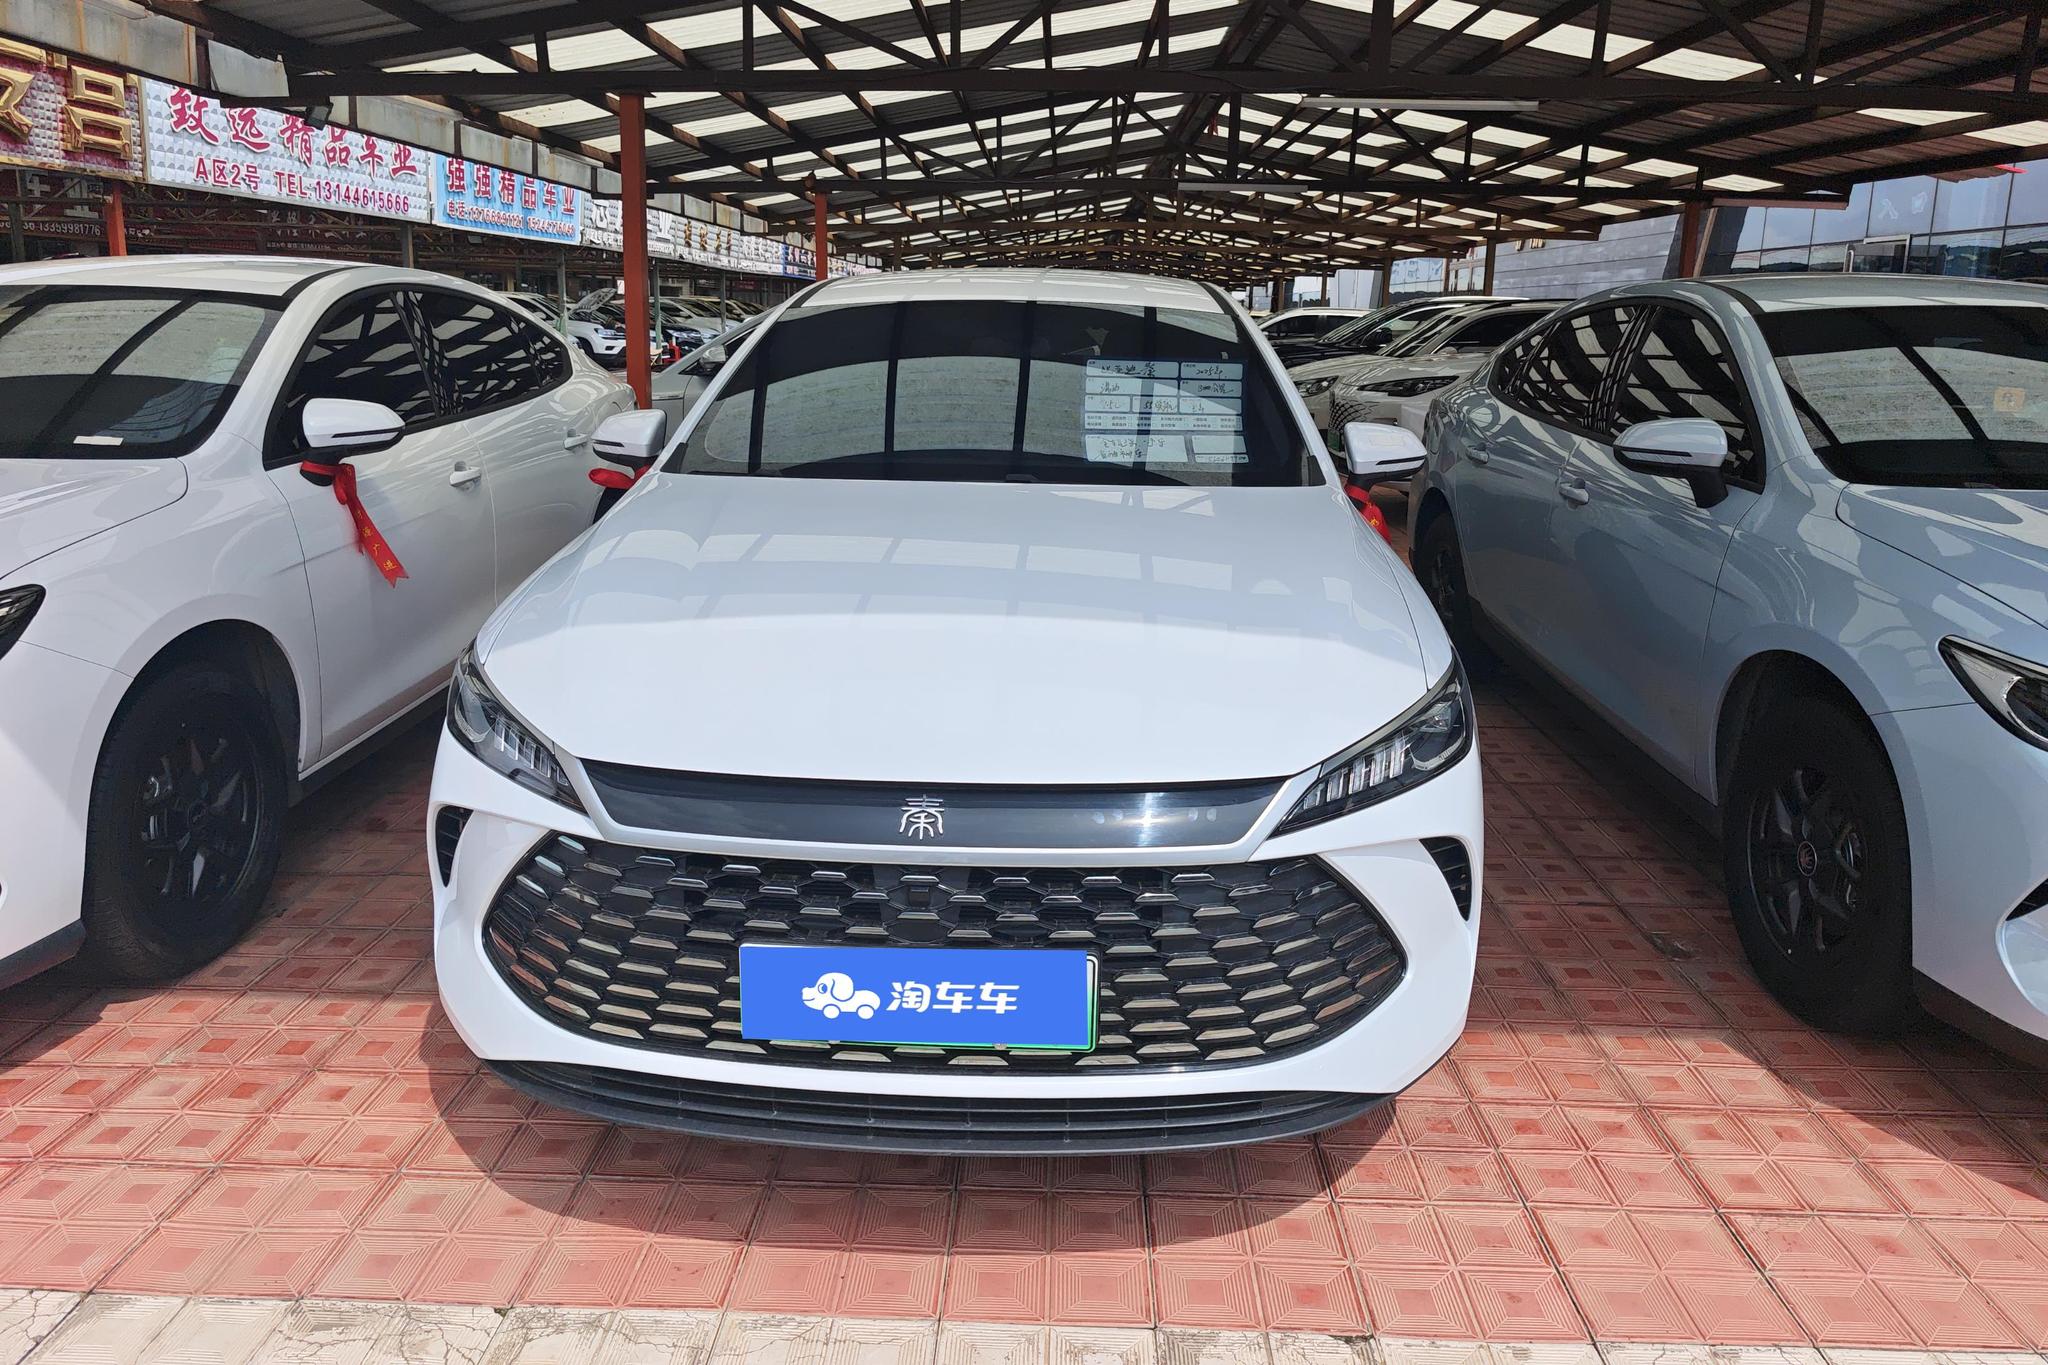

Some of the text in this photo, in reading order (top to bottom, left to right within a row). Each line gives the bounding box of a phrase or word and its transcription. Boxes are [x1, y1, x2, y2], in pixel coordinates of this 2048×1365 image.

[194, 158, 260, 192] A区2号
[447, 158, 574, 216] 强强精品车业
[899, 794, 945, 840] 秦
